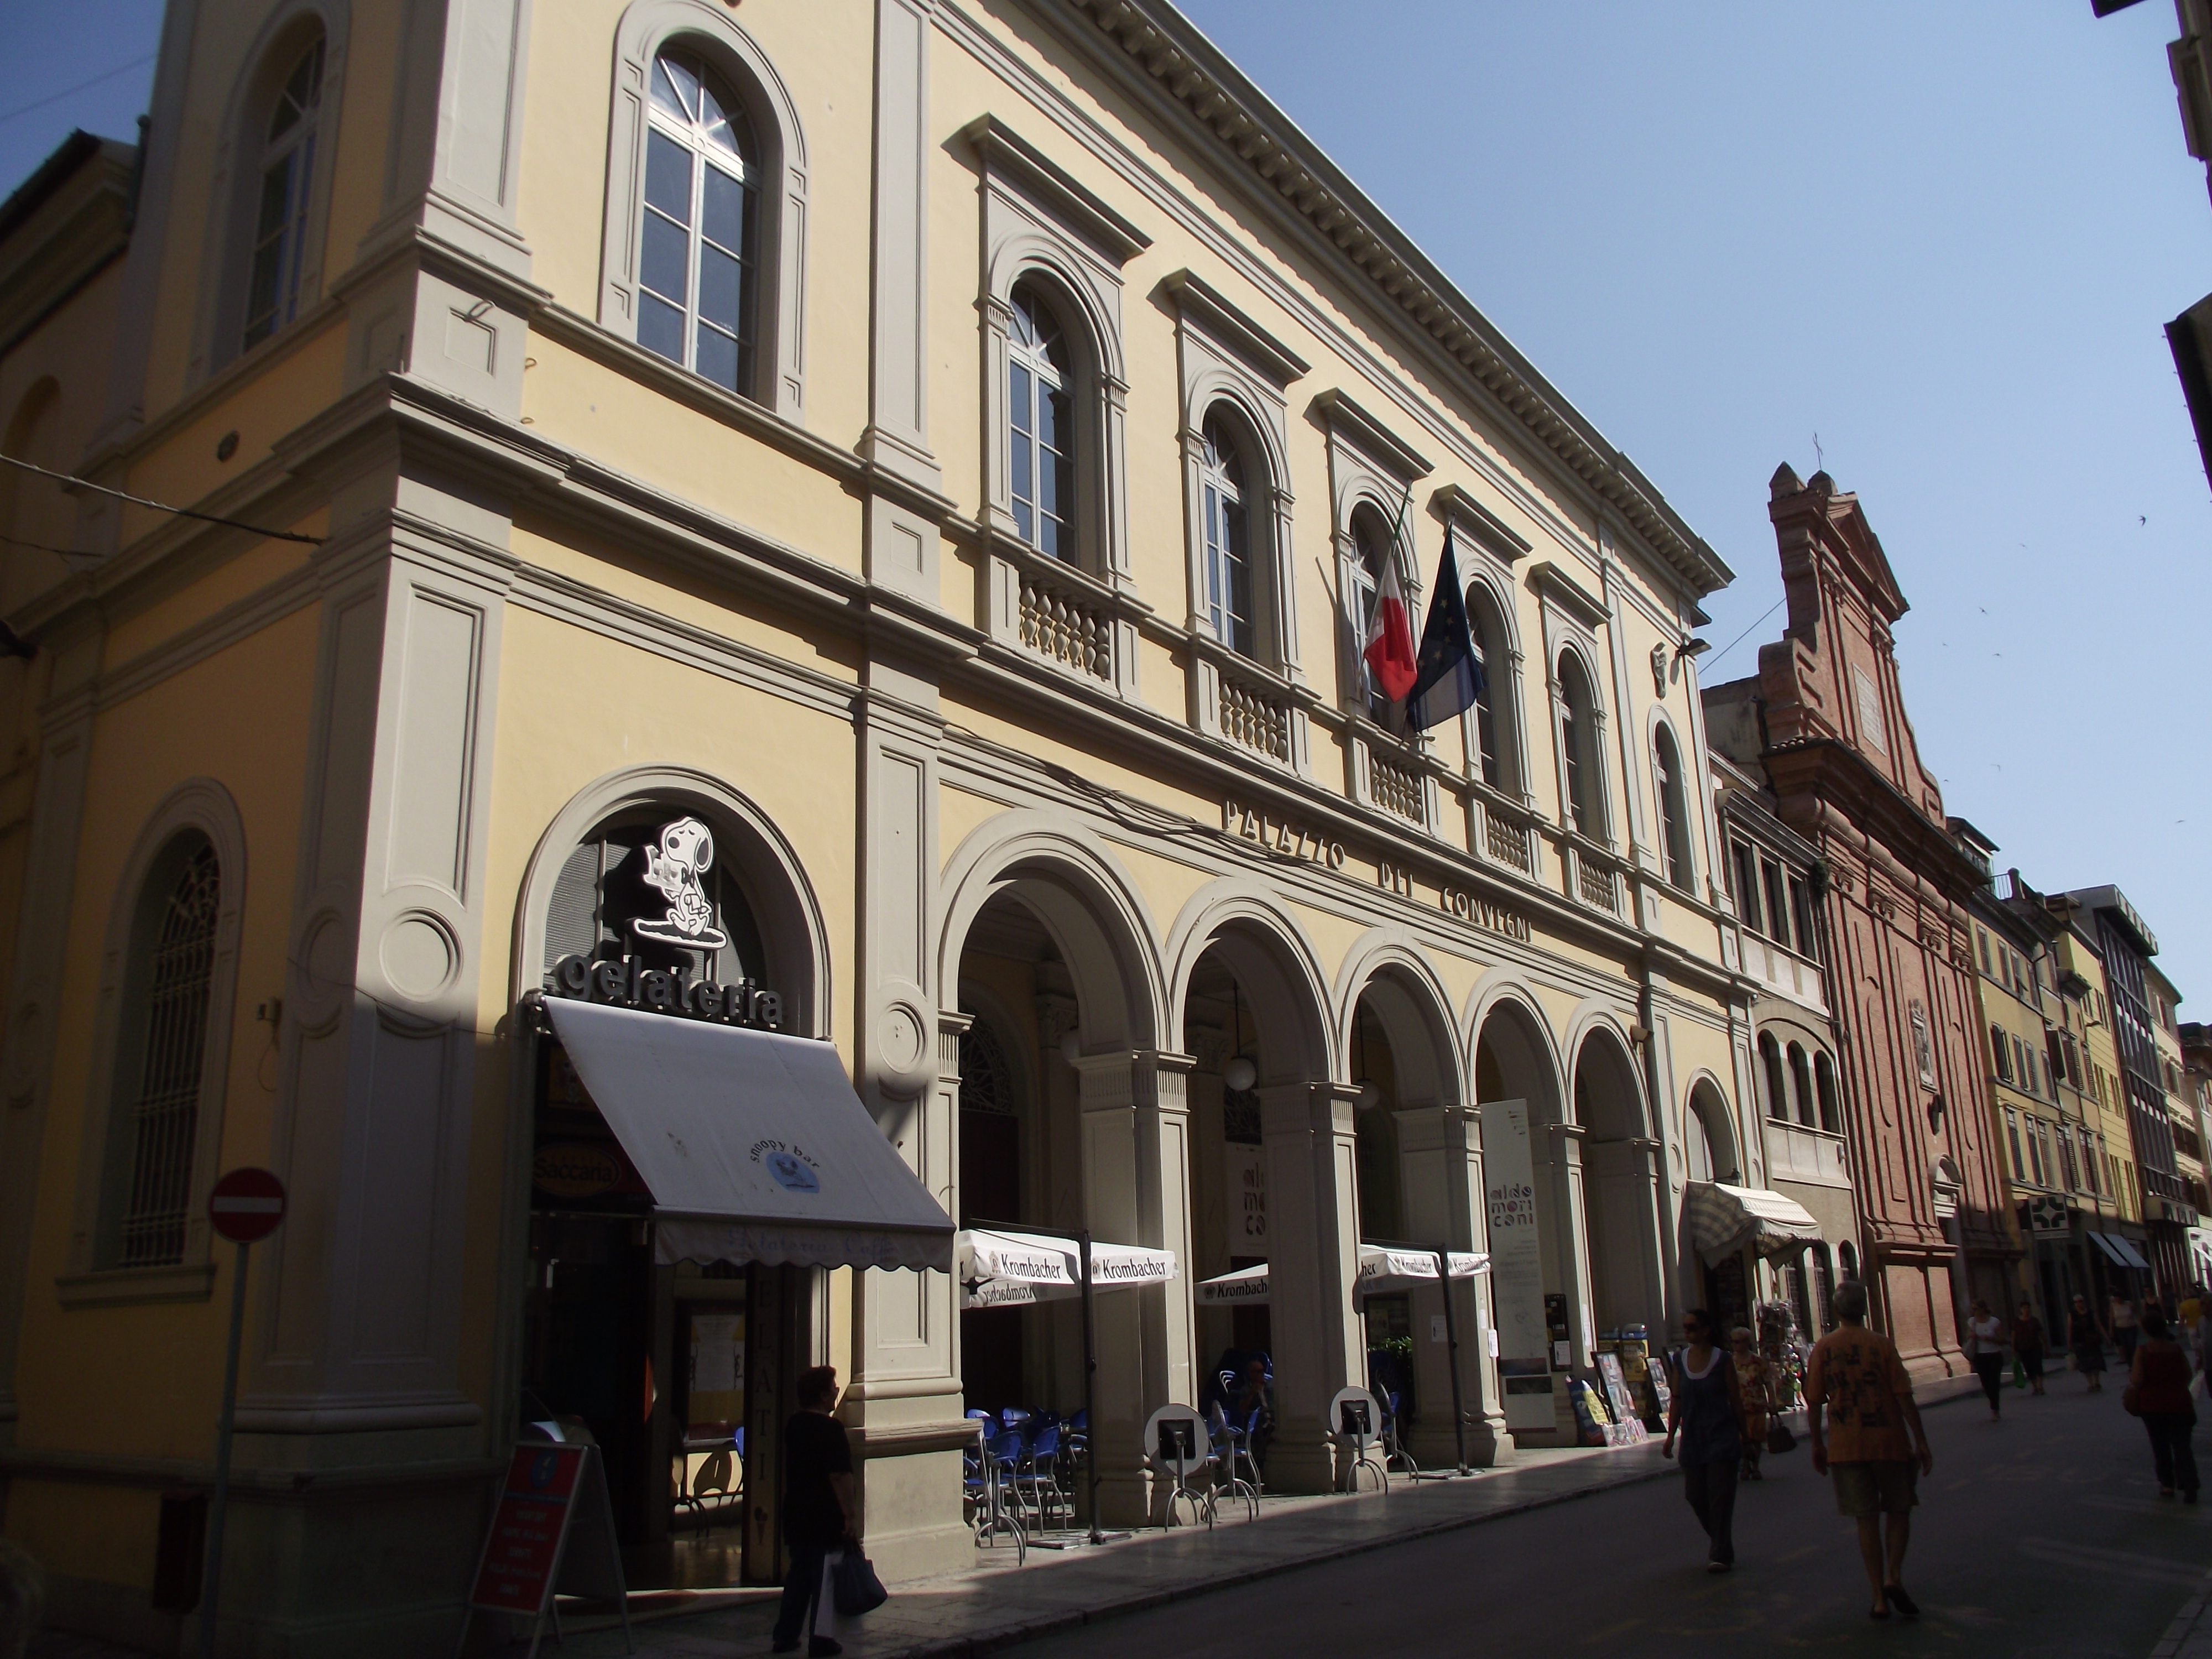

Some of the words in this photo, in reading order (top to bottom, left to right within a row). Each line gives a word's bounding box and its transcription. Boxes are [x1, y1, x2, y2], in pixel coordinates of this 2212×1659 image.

[1226, 800, 1345, 870] PALAZZO
[1381, 862, 1413, 898] DEI
[1442, 886, 1532, 943] CONVEGNI
[556, 953, 784, 1026] gelateria
[750, 1139, 786, 1163] snoopy
[793, 1145, 820, 1167] bar
[534, 1157, 612, 1182] Saccaria
[1490, 1183, 1532, 1200] aldo
[1492, 1199, 1532, 1213] mori
[1494, 1213, 1533, 1227] coni
[727, 1226, 828, 1254] Gelateria
[1001, 1254, 1061, 1279] Krombacher
[1103, 1257, 1166, 1280] Krombacher
[1217, 1278, 1269, 1298] Krombach
